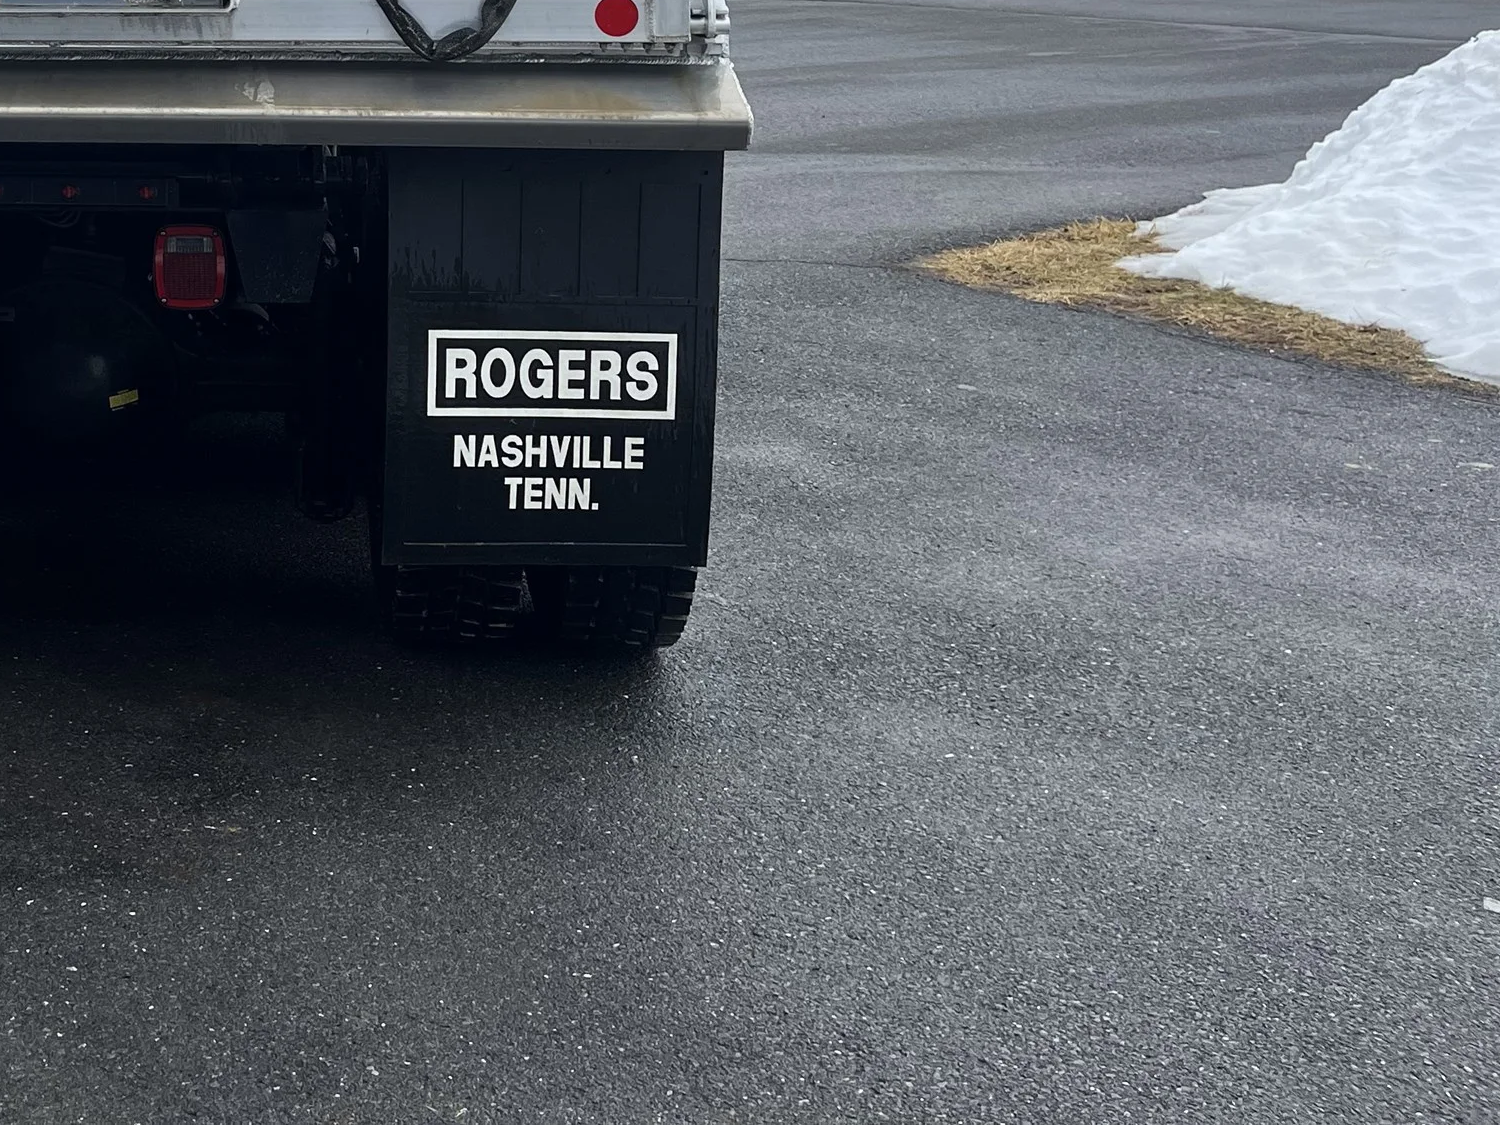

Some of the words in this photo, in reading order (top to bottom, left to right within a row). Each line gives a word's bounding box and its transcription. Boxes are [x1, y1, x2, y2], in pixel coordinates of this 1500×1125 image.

[445, 347, 660, 401] ROGERS
[453, 434, 645, 470] NASHVILLE
[503, 477, 599, 511] TENN.
